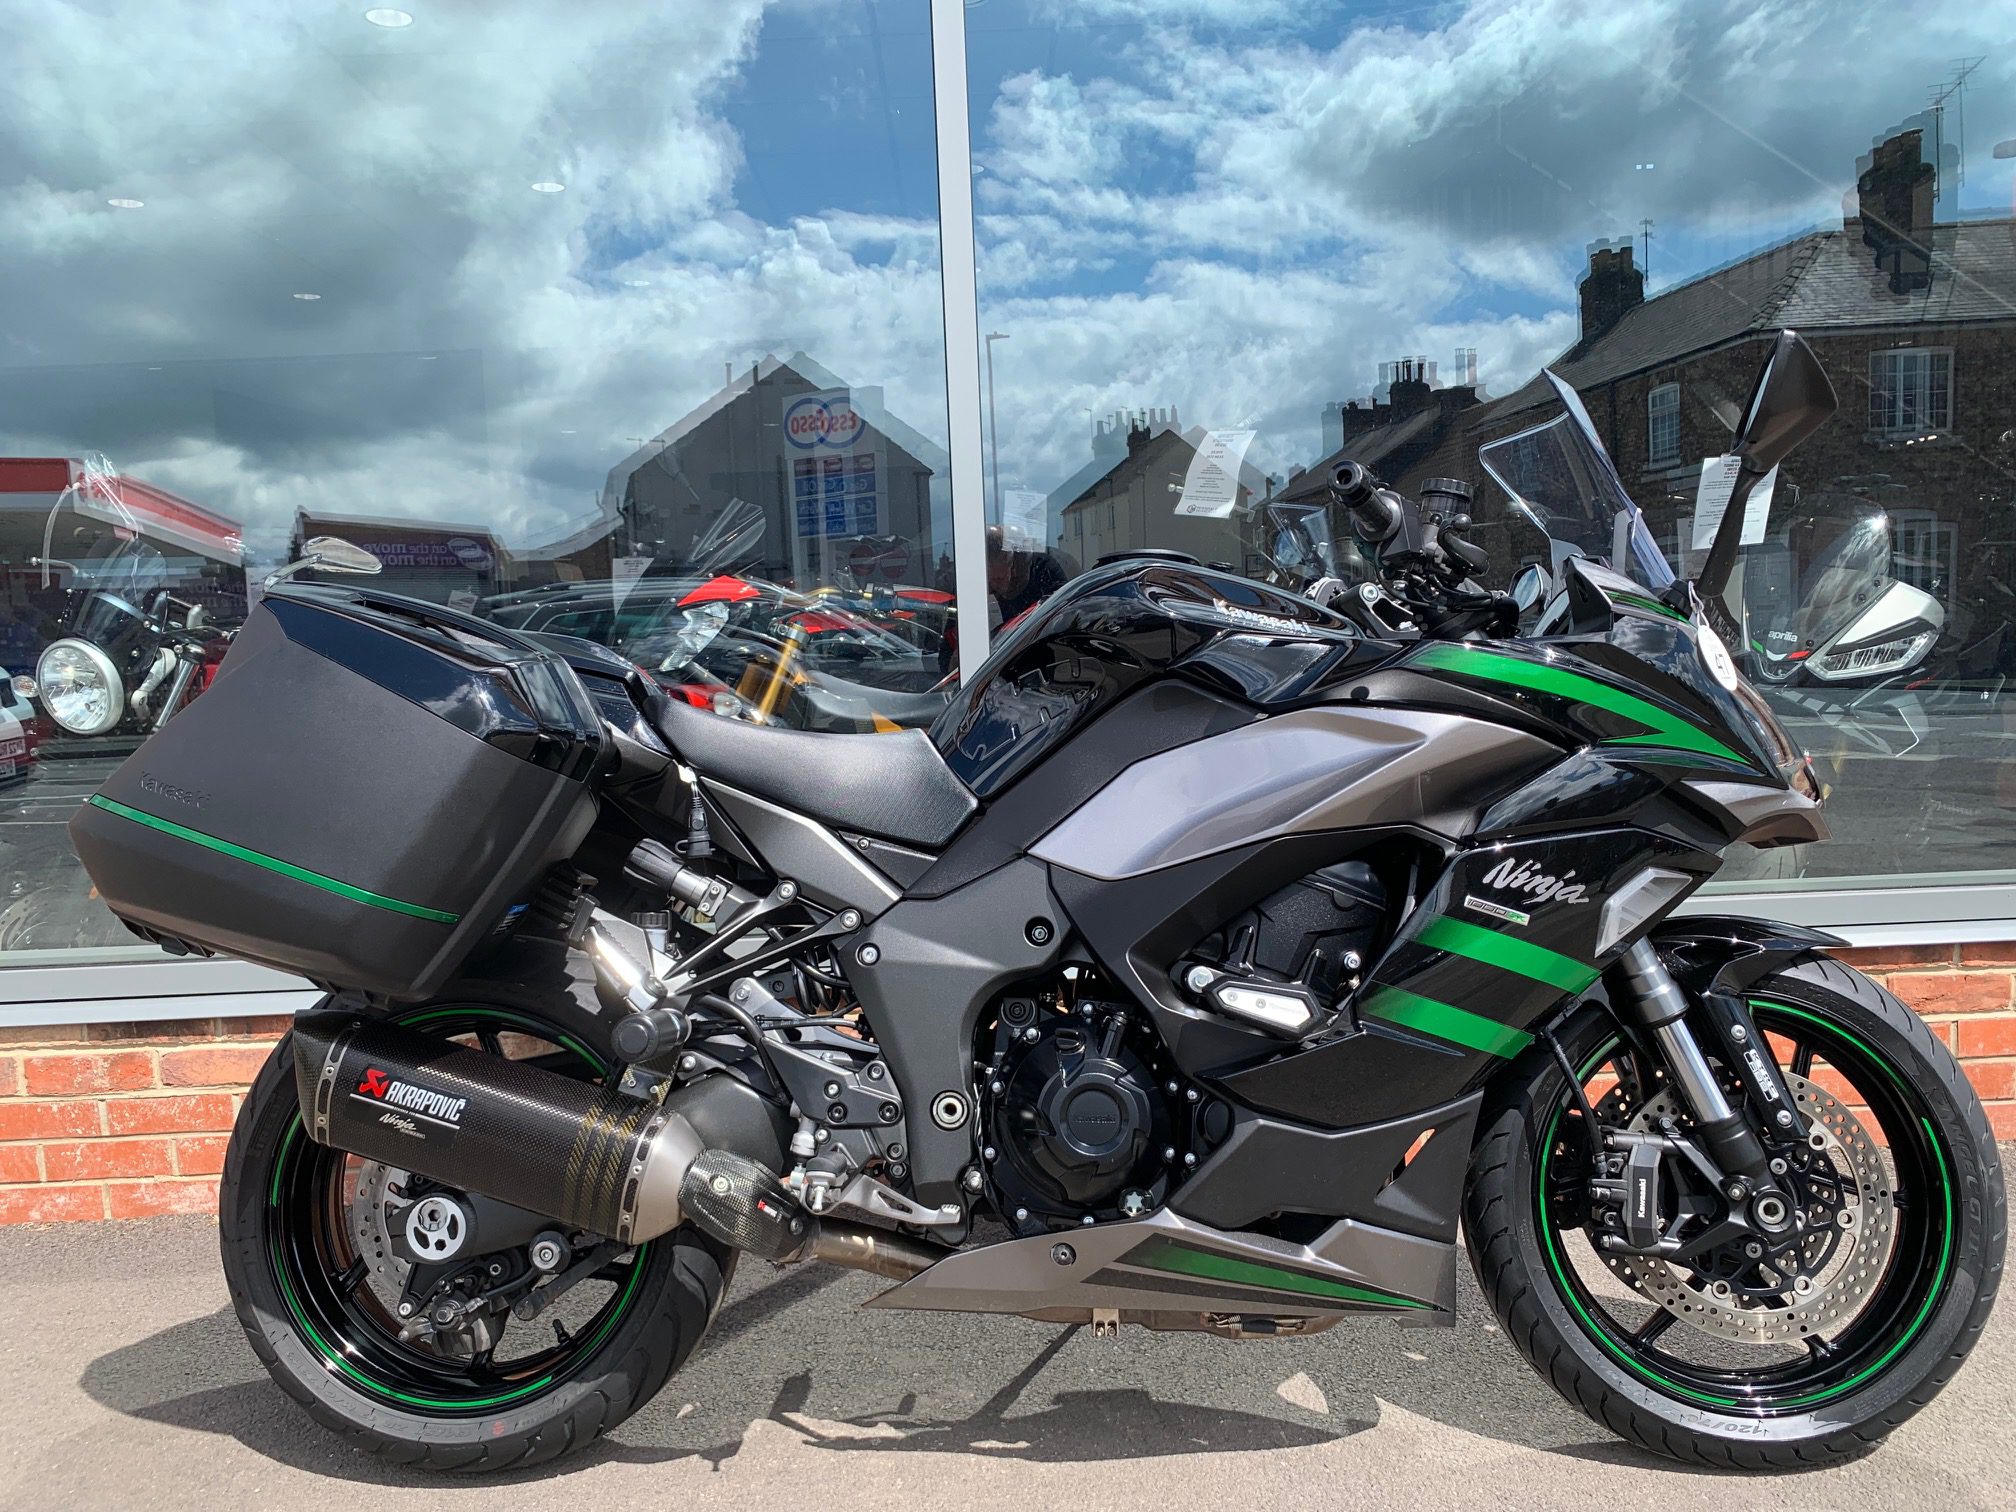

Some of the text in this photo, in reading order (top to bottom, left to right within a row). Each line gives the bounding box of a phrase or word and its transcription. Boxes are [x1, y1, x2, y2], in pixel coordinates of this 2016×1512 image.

[1213, 598, 1312, 634] Kawasaki
[1767, 630, 1798, 643] aprilia
[1482, 857, 1590, 905] Ninja
[379, 1112, 417, 1131] Ninja
[1637, 1178, 1647, 1218] Kawasaki
